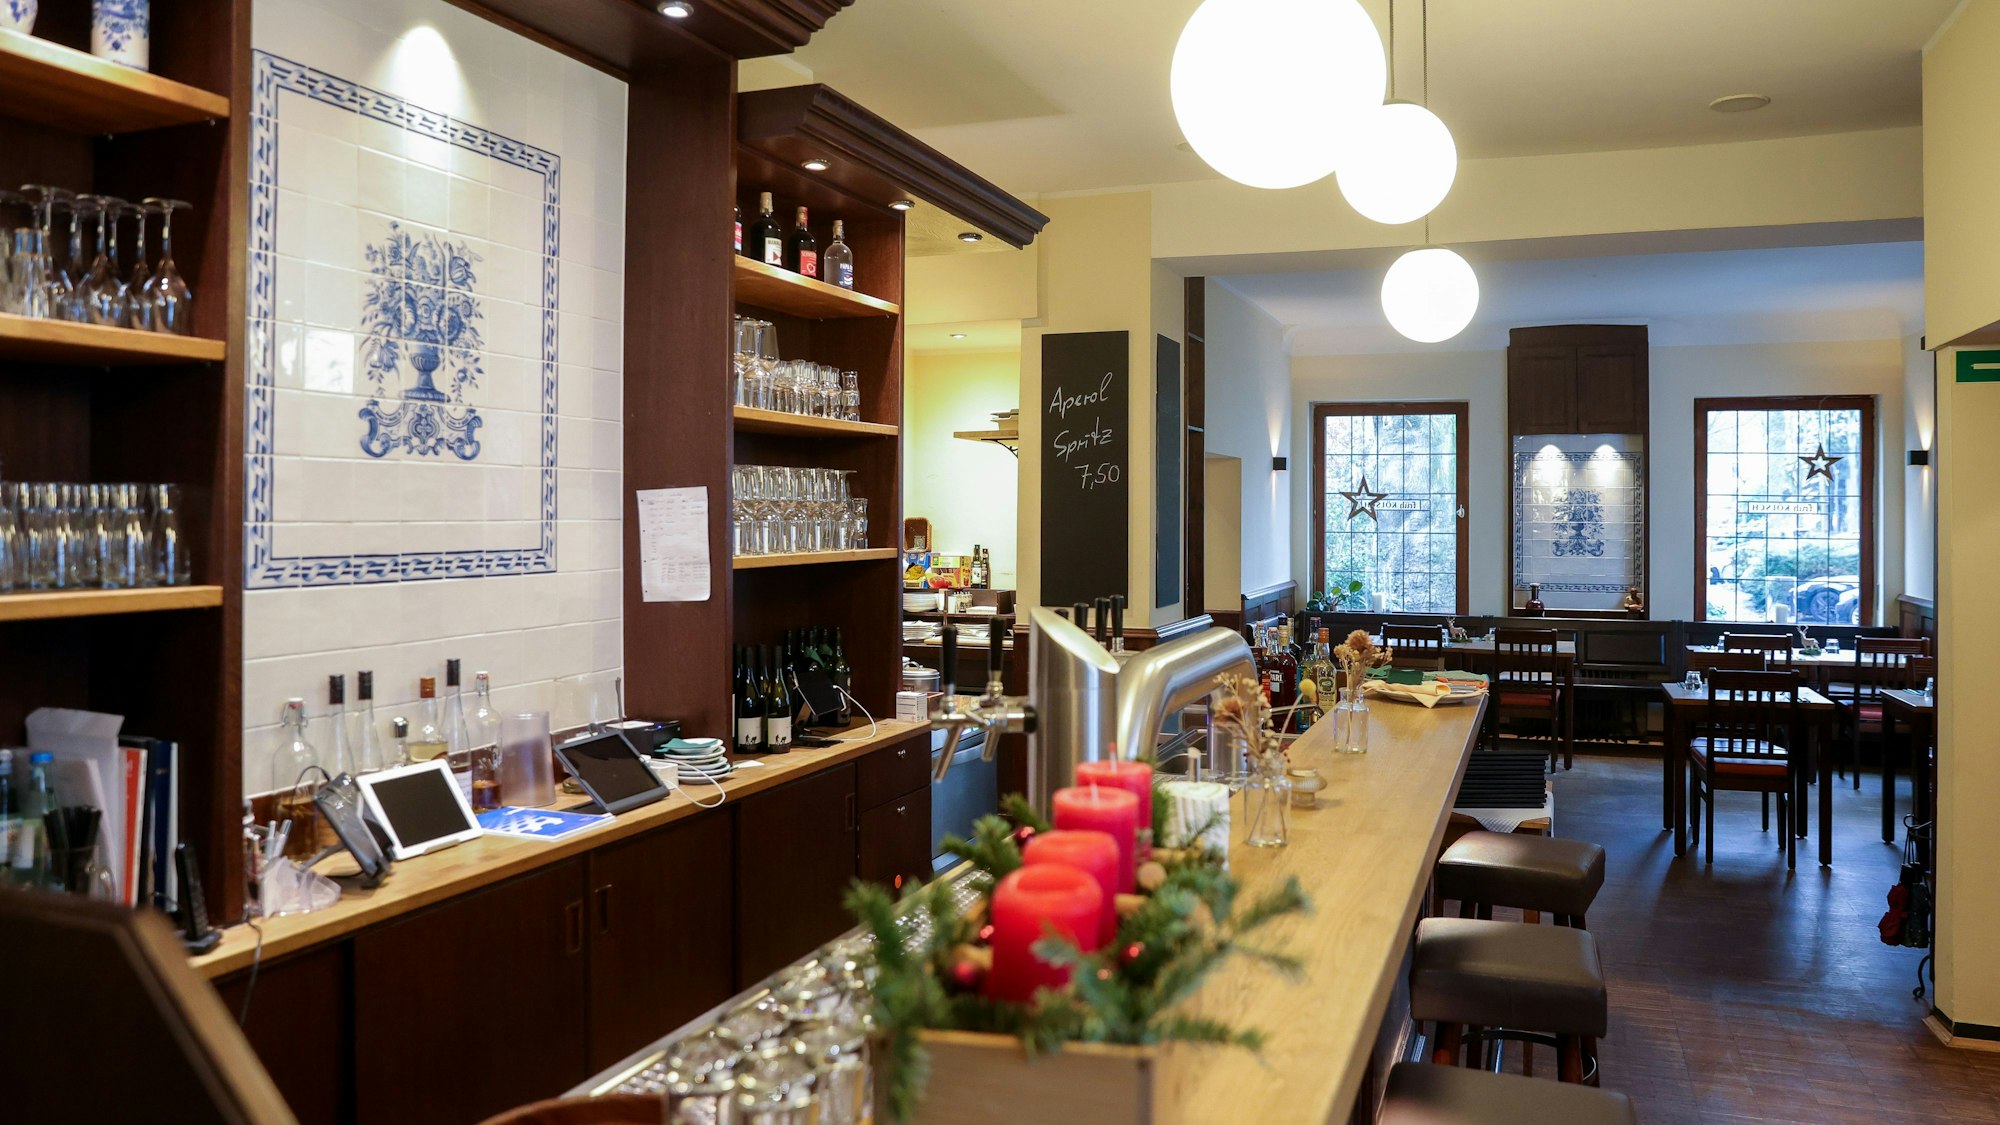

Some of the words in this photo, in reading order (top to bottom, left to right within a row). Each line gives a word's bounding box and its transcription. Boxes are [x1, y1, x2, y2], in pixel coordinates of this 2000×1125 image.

[1049, 372, 1113, 419] Aperol
[1053, 416, 1113, 463] Spritz
[1074, 462, 1120, 490] 7,50
